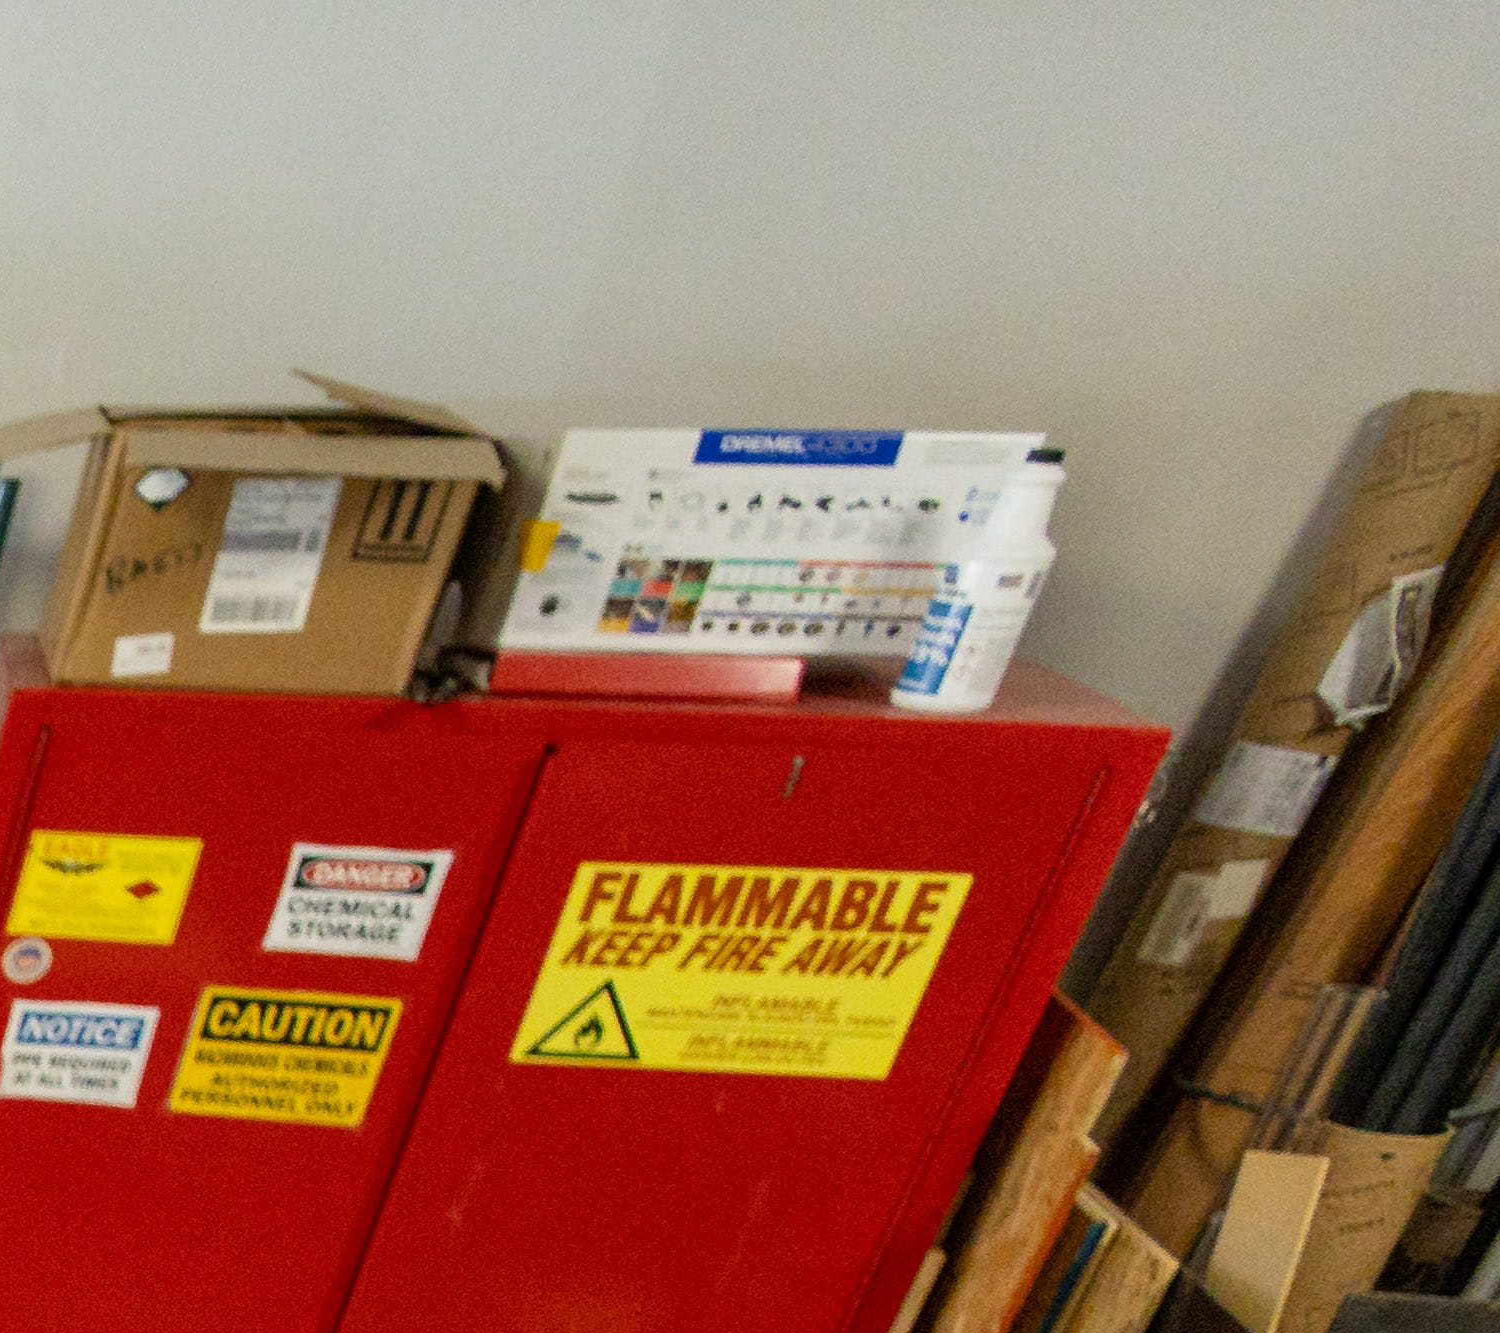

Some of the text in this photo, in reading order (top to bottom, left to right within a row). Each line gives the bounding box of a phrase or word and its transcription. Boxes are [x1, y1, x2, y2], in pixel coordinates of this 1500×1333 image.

[313, 862, 413, 888] DANGER
[287, 896, 413, 921] CHEMICAL
[577, 871, 950, 934] FLAMMABLE
[287, 918, 402, 942] STORAGE
[560, 928, 927, 979] KEEP FIRE AWAY
[21, 1014, 140, 1047] NOTICE
[207, 1001, 386, 1048] CAUTION
[178, 1087, 356, 1117] PERSONNEL ONLY
